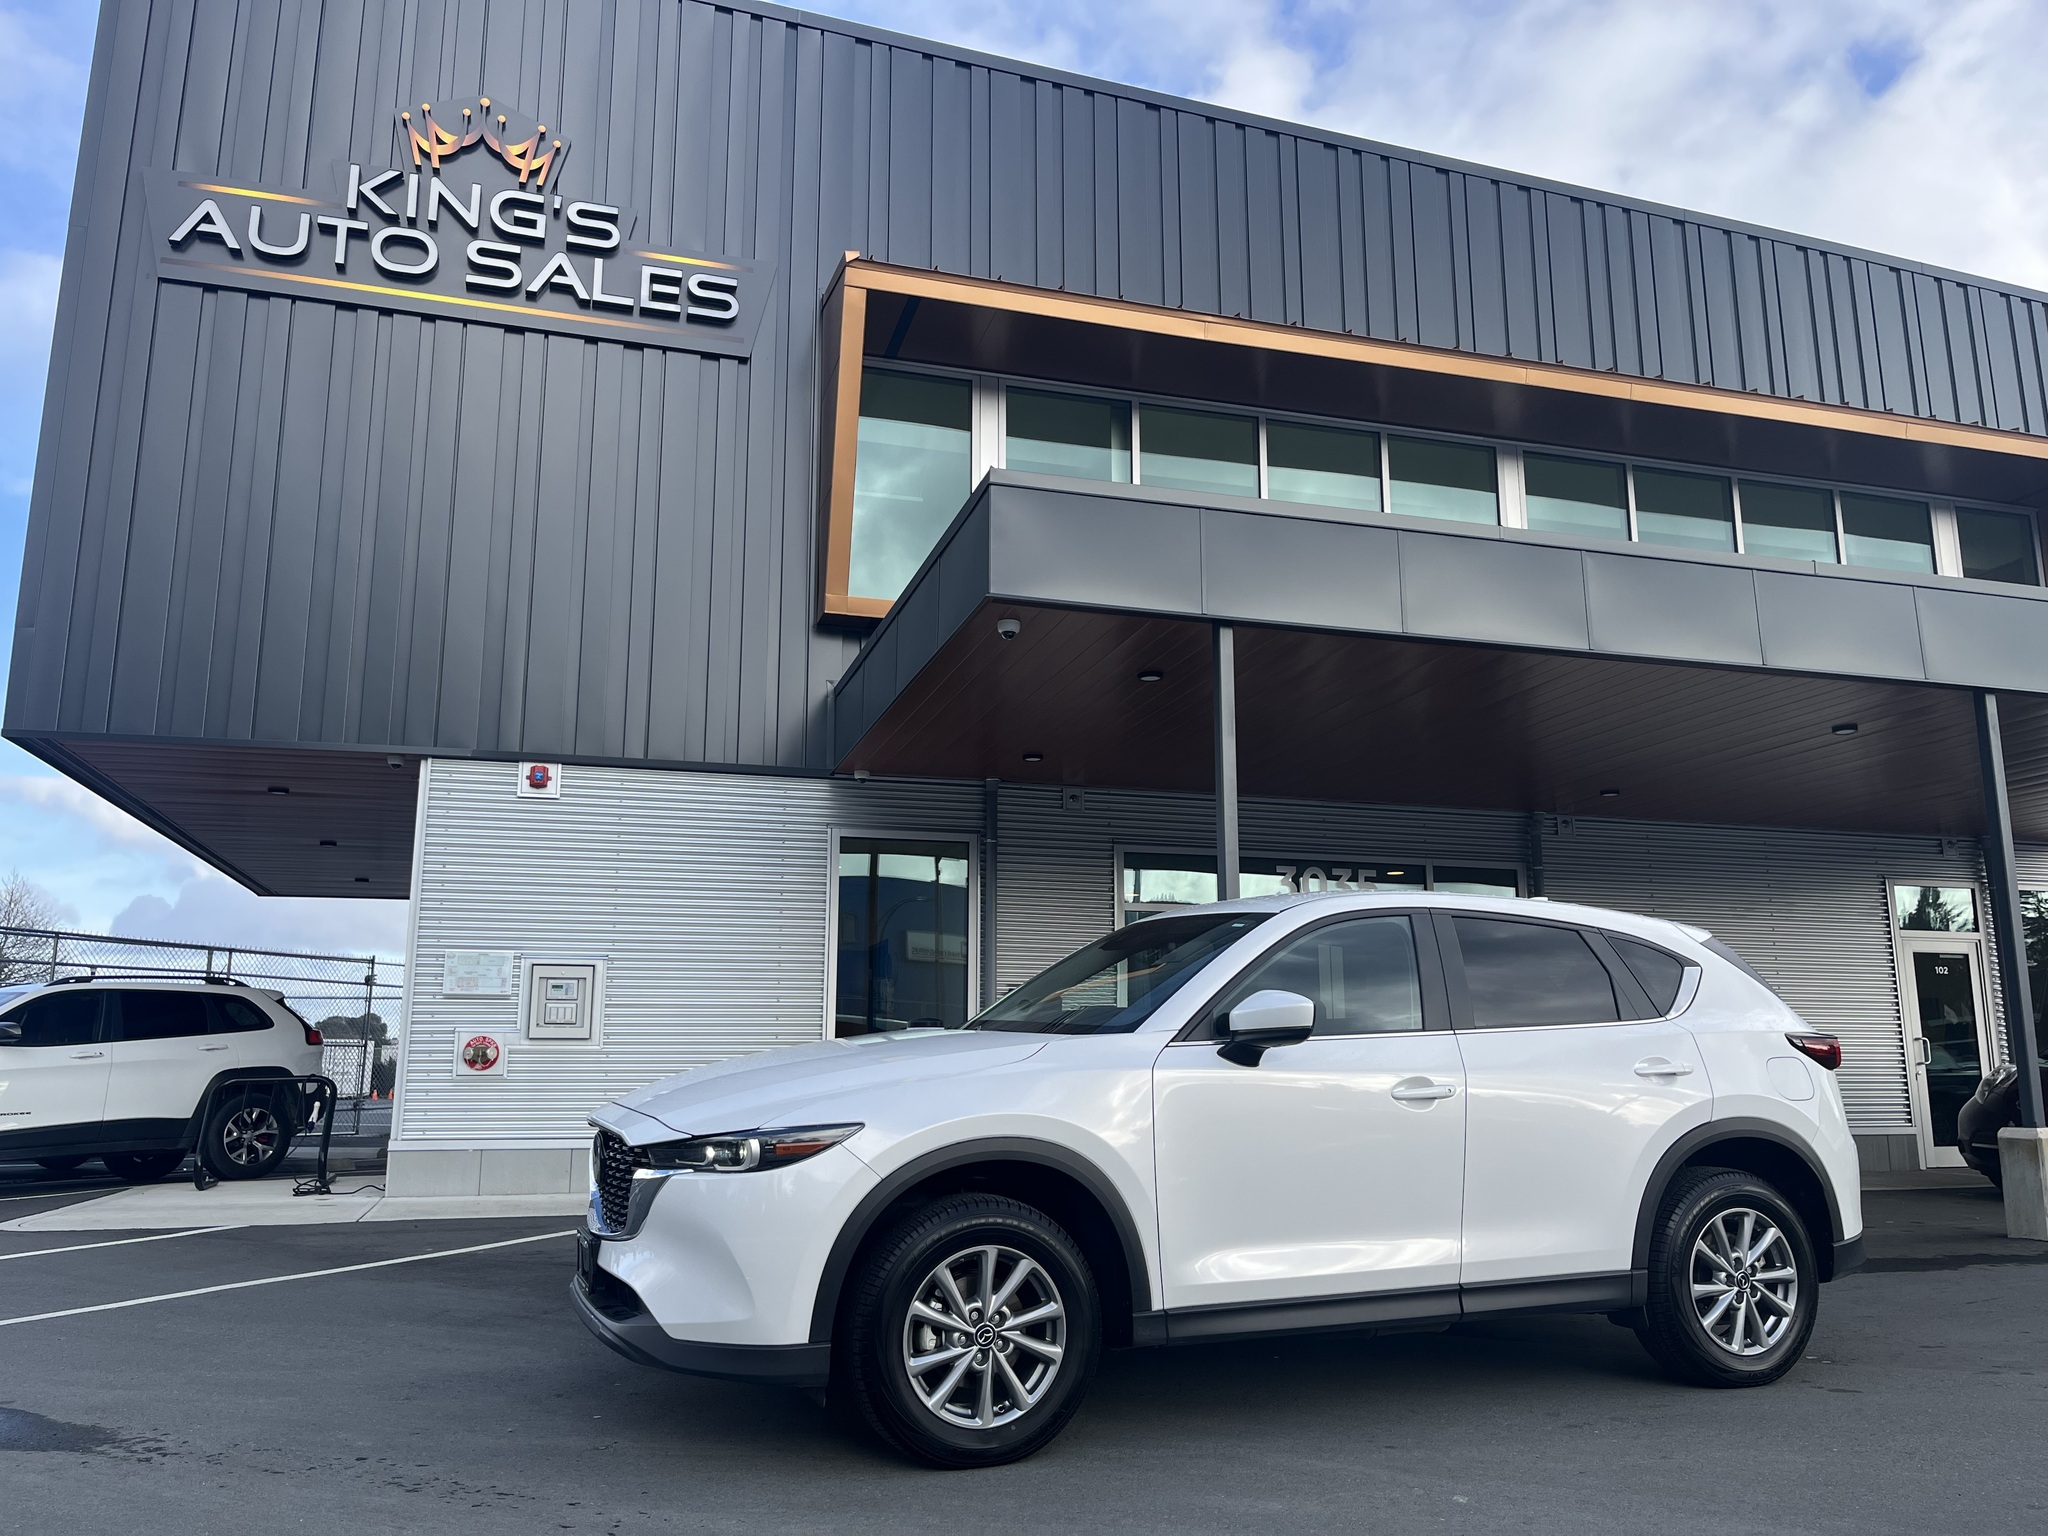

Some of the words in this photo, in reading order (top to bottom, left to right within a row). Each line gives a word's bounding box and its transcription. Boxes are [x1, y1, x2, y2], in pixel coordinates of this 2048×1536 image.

[345, 164, 622, 250] KING'S
[168, 198, 440, 276] AUTO
[465, 239, 740, 321] SALES
[1934, 966, 1949, 975] 102
